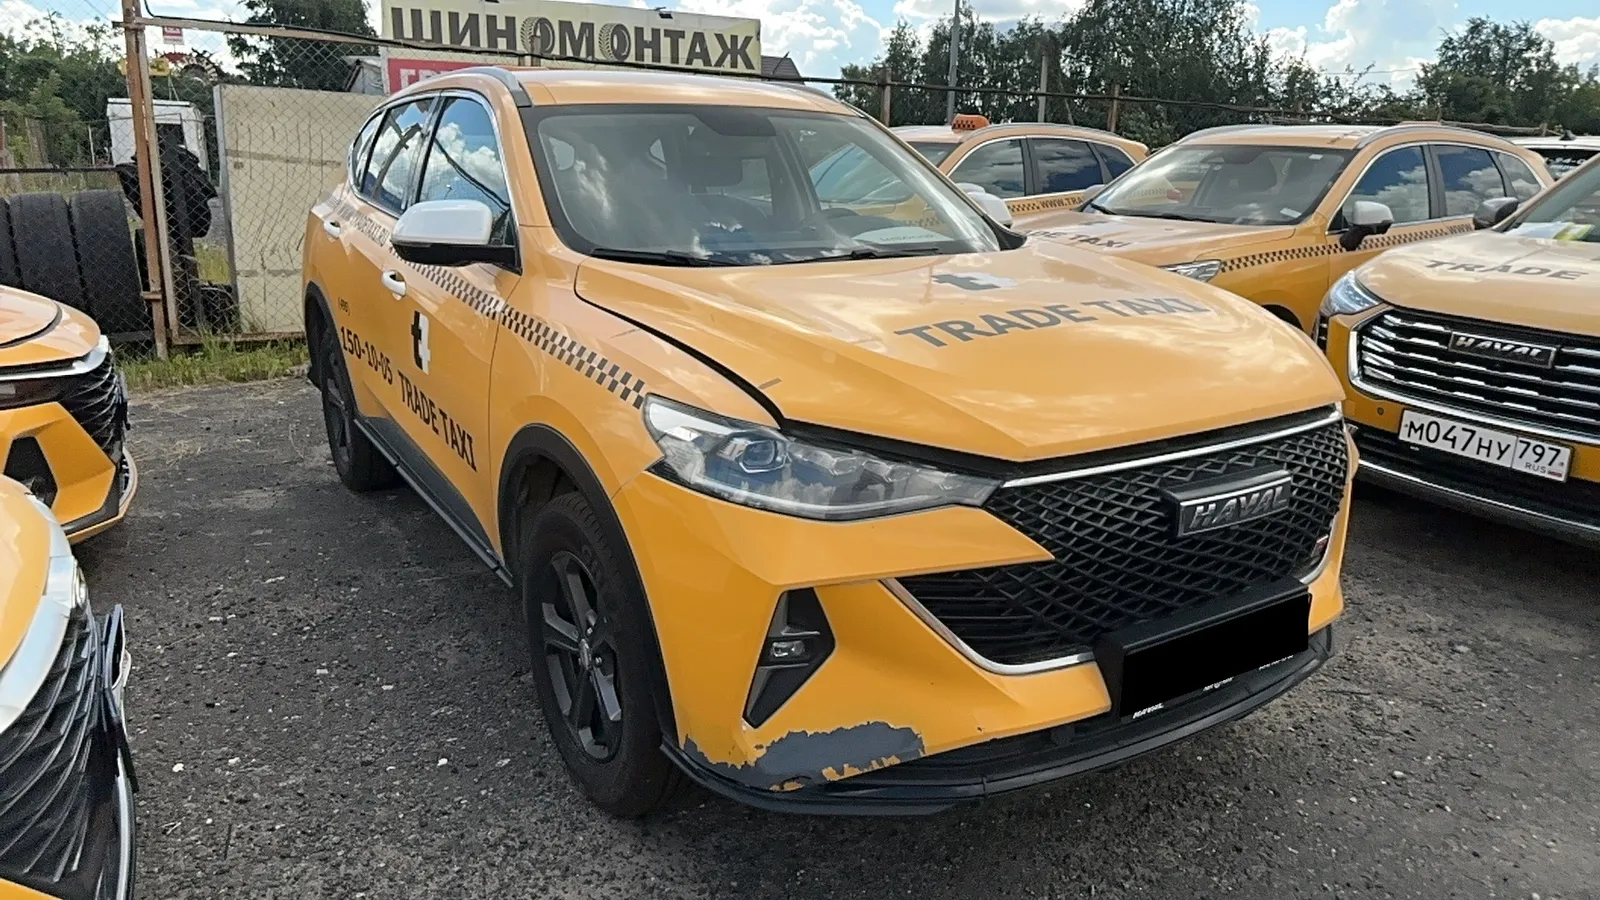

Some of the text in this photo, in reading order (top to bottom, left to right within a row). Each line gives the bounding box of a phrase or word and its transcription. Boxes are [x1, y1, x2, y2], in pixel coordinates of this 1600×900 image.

[391, 7, 755, 70] ШИНОМОНТАЖ
[1426, 259, 1588, 280] TRADE
[894, 297, 1214, 348] TRADE TAXI
[341, 326, 478, 474] 150-10-05 TRADE TAXI
[1518, 440, 1561, 467] 797
[1524, 462, 1547, 475] RUS
[1189, 485, 1289, 529] HAVAL
